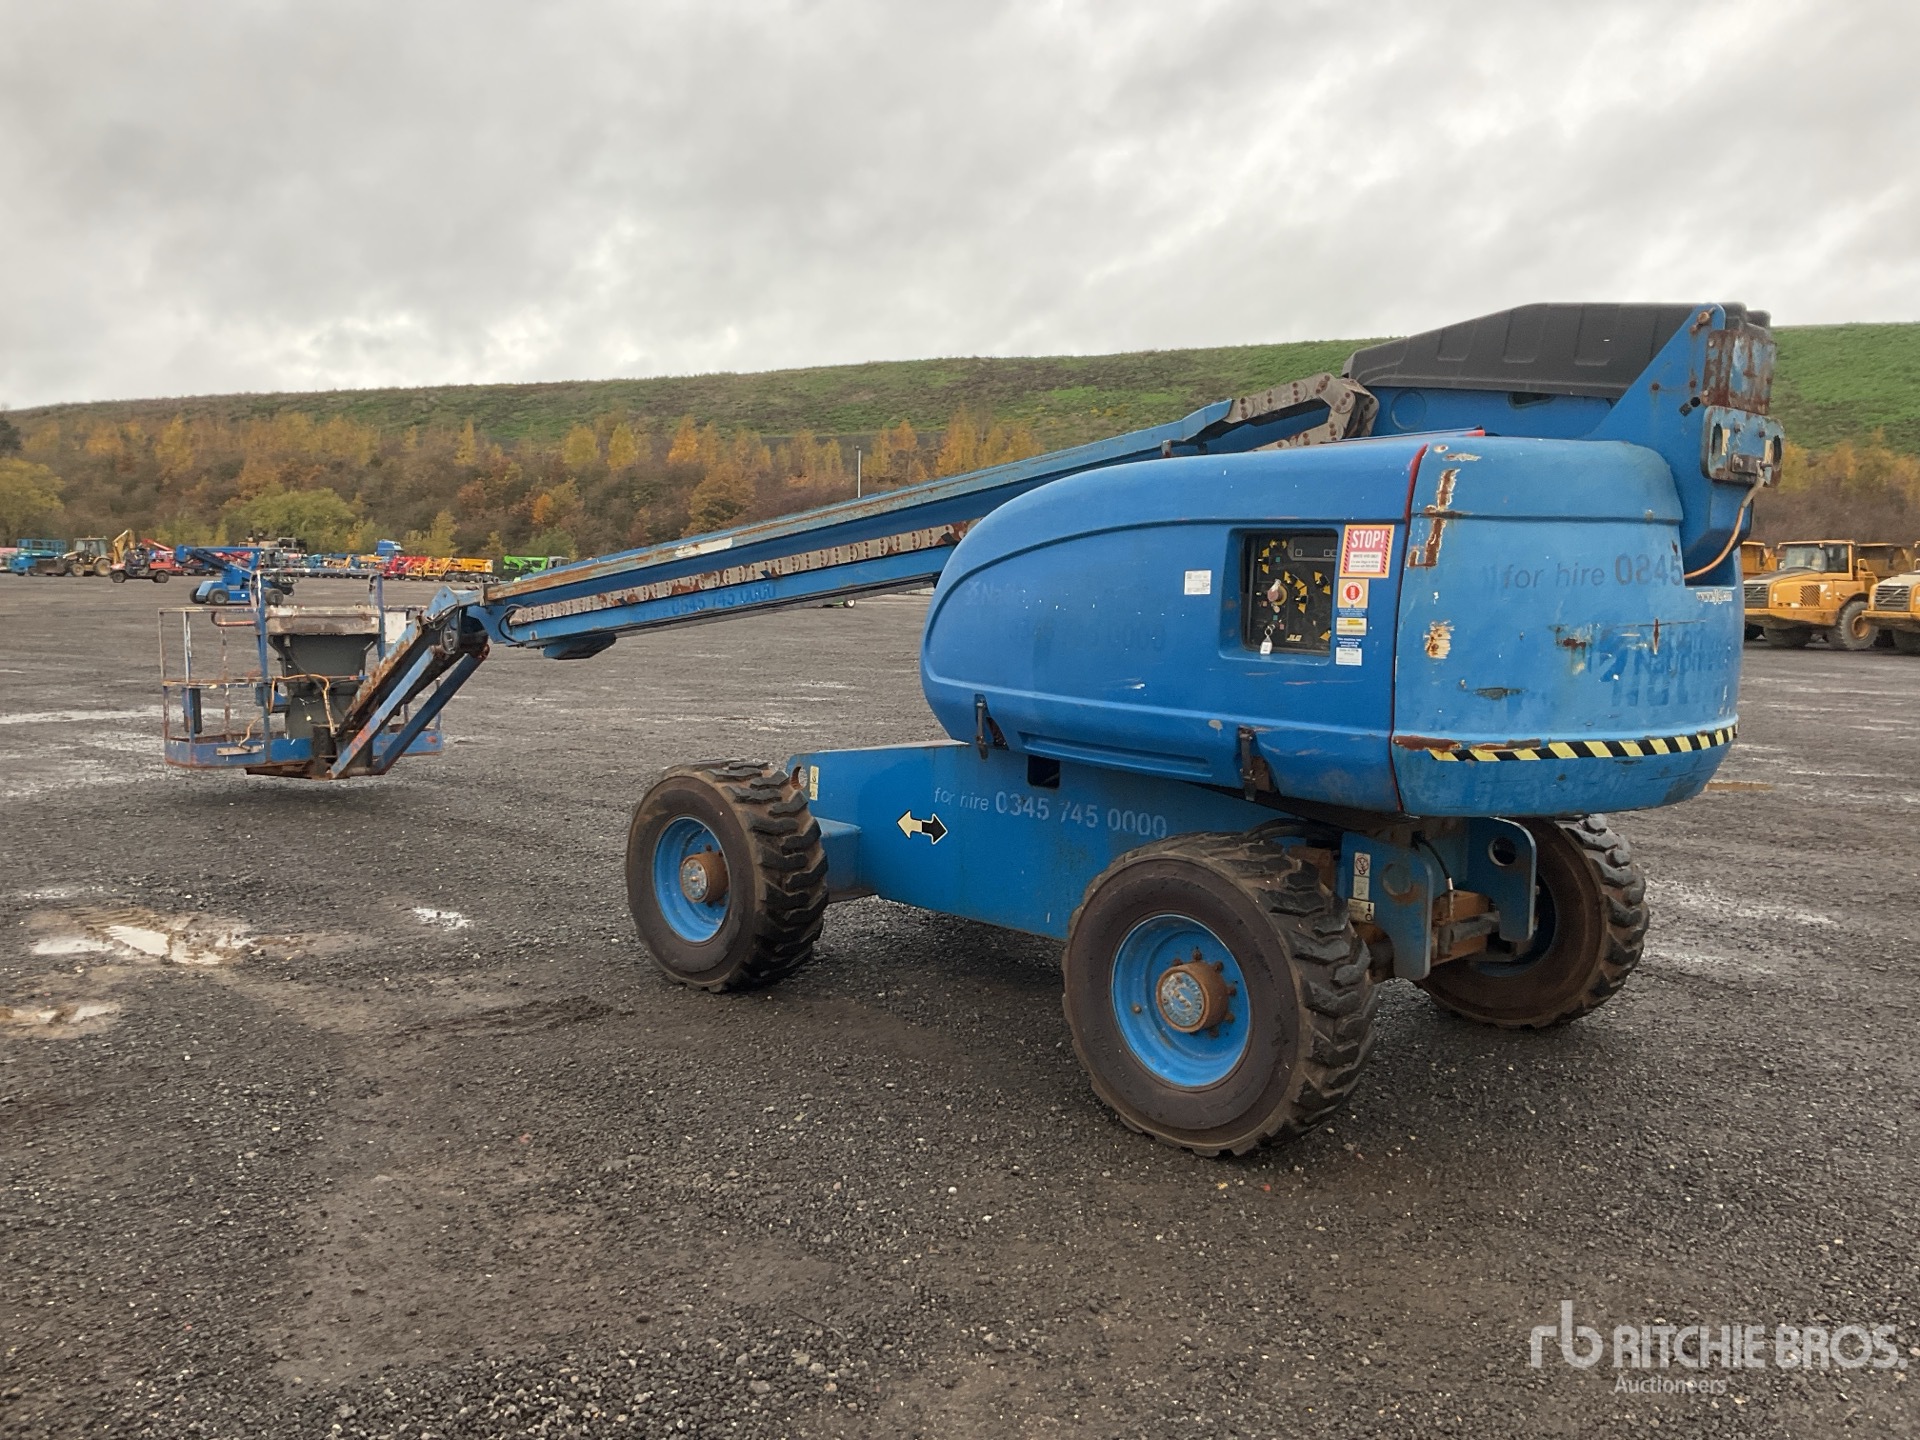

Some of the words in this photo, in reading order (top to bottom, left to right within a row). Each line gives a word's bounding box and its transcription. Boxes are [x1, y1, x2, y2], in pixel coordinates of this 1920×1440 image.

[1351, 530, 1385, 549] STOP!
[1502, 564, 1544, 589] for
[1555, 562, 1605, 587] hire
[934, 787, 955, 805] for
[959, 792, 989, 811] hire
[995, 791, 1050, 821] 0345
[1058, 801, 1100, 828] 745
[1107, 808, 1168, 839] 0000
